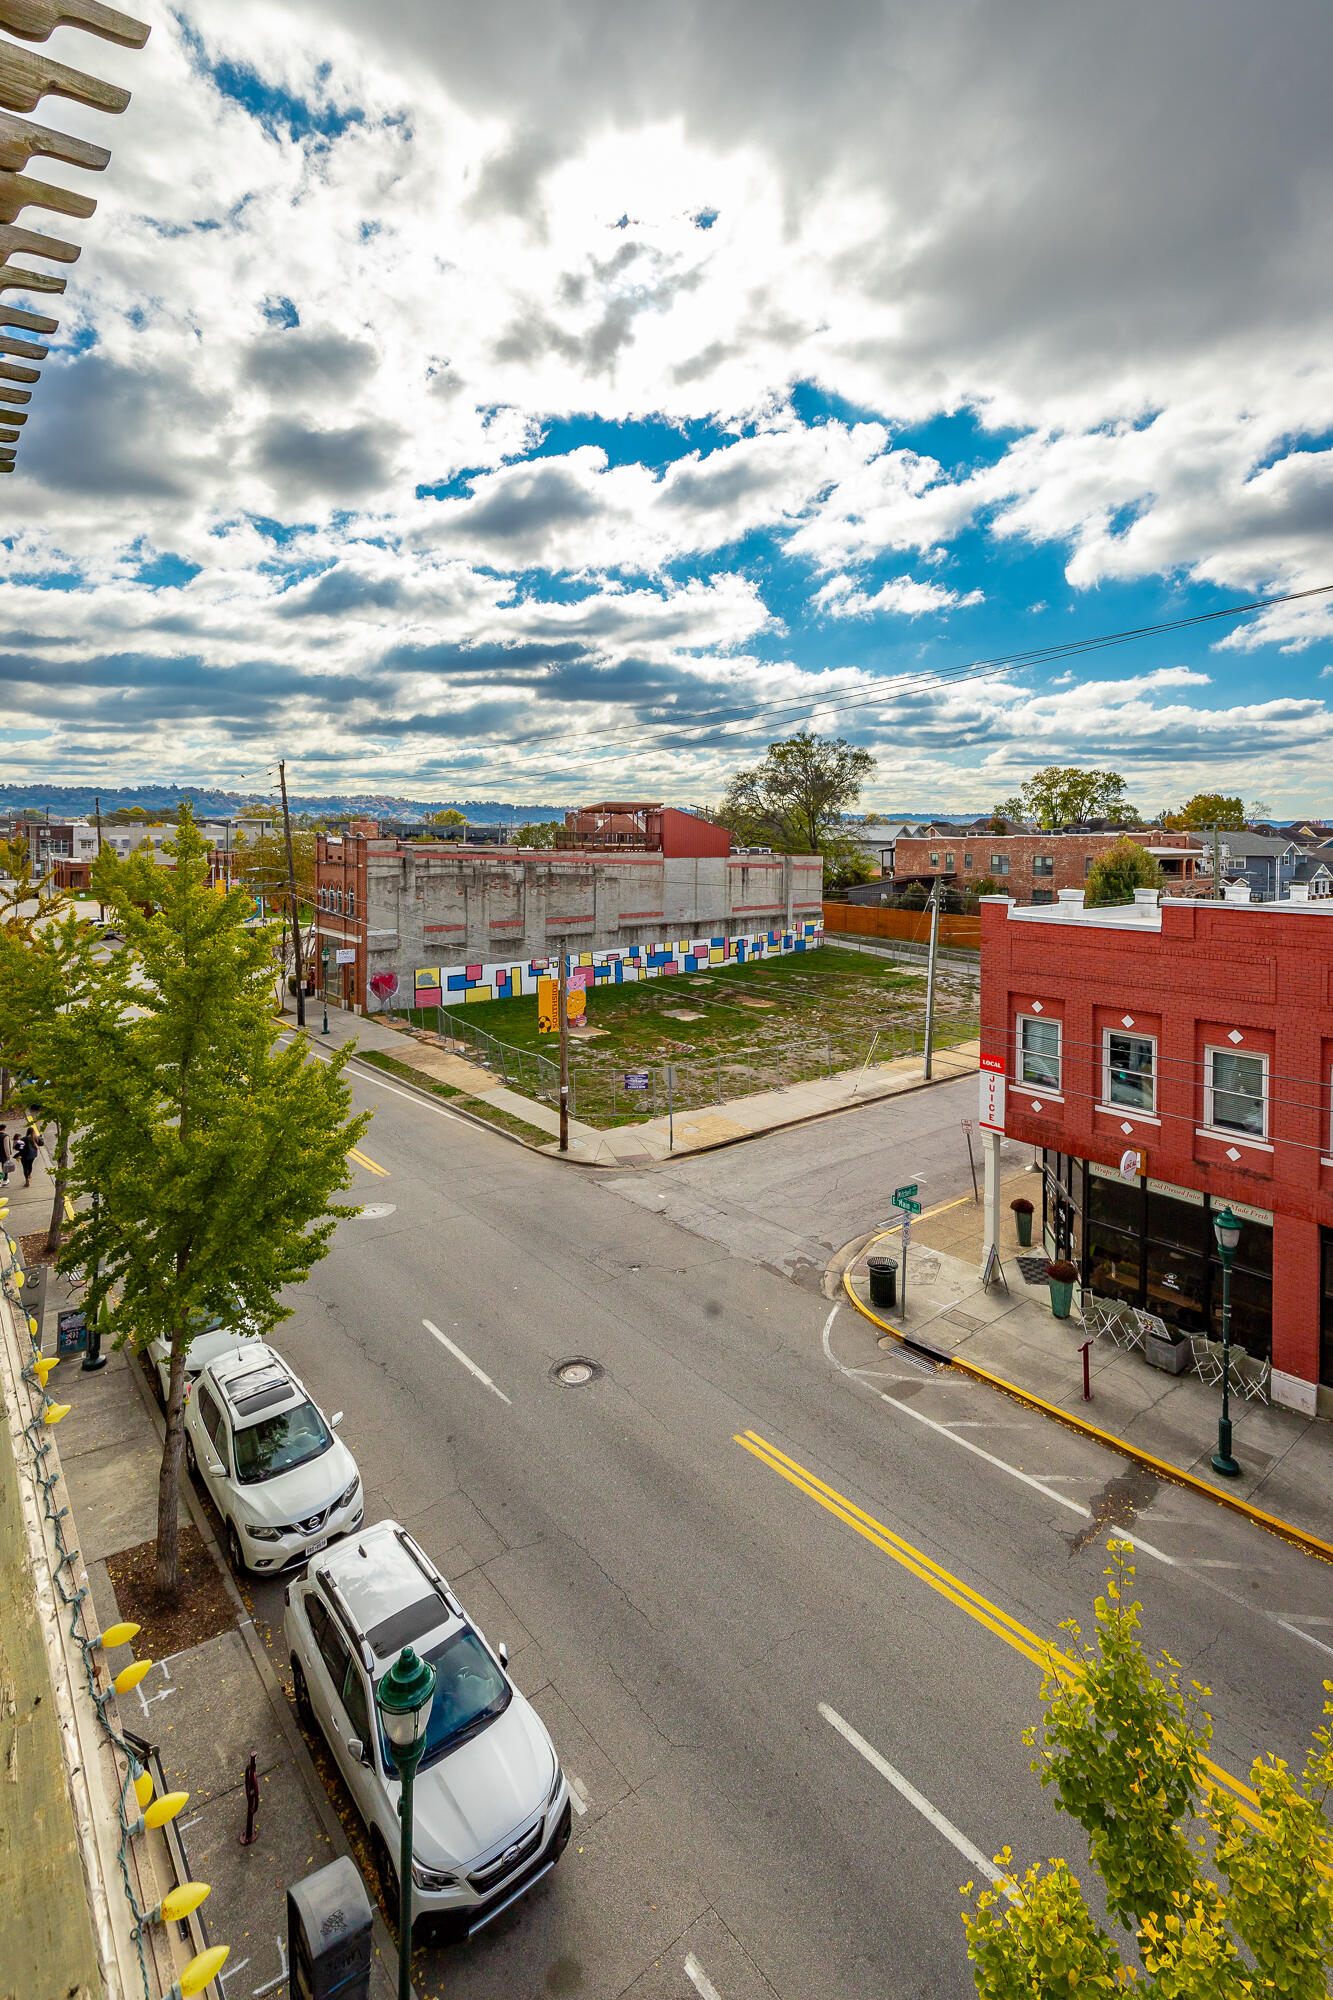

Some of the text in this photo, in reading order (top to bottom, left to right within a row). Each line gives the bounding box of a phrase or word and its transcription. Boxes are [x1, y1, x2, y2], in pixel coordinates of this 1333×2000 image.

[982, 1059, 1003, 1069] LOCAL
[988, 1075, 996, 1122] JUICE
[1124, 1160, 1137, 1171] LOCAL
[1149, 1181, 1201, 1200] Cold Pressed Juice
[898, 1199, 910, 1210] Main
[1249, 1210, 1269, 1220] Fresh
